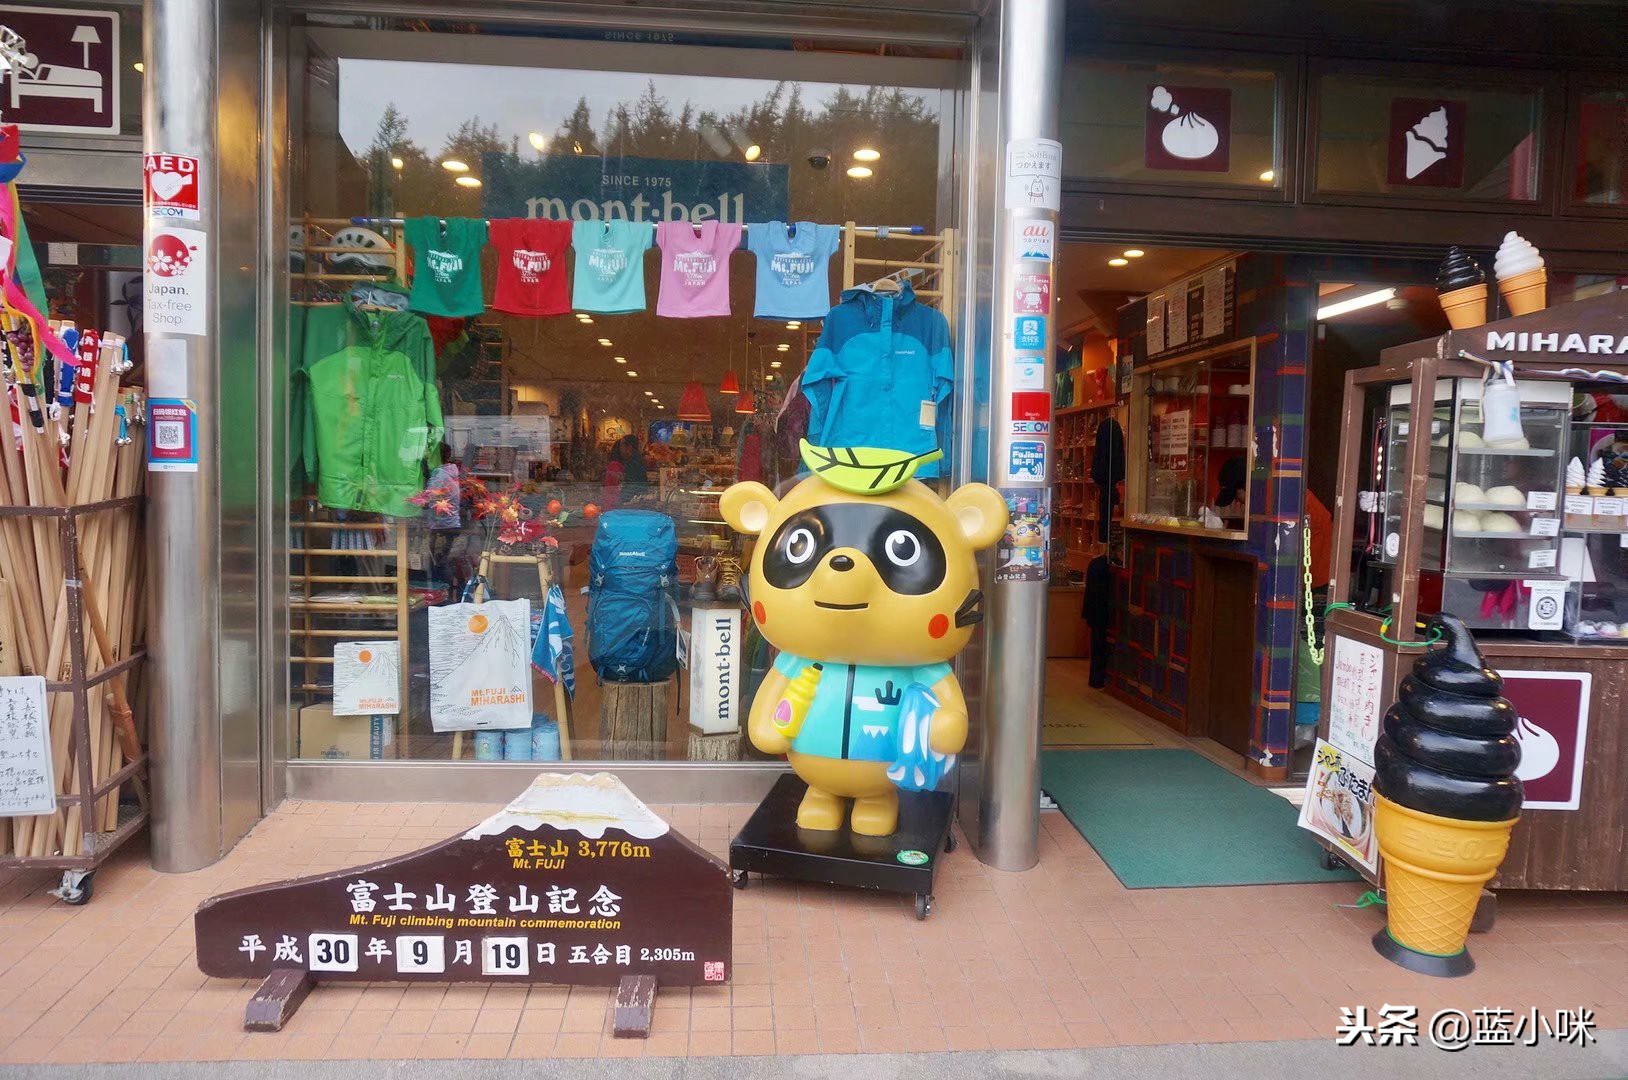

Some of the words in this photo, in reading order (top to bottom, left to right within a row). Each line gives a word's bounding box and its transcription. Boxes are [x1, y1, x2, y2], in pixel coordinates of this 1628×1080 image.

[146, 155, 195, 173] AED
[1016, 161, 1050, 170] つかえます
[602, 174, 640, 186] SINCE
[644, 176, 672, 187] 1975
[1024, 226, 1049, 237] au
[149, 284, 189, 296] Japan.
[147, 298, 192, 312] Tax-free
[153, 312, 182, 326] Shop
[1013, 422, 1049, 432] SECOM
[1012, 451, 1043, 459] Fujisan
[471, 688, 506, 697] Mt.FUJI
[471, 694, 525, 707] MIHARASHI
[505, 838, 568, 858] 富士山
[578, 841, 650, 858] 3,776m
[513, 859, 531, 869] Mt.
[535, 859, 565, 869] FUJI
[346, 880, 622, 917] 富士山登山記念
[350, 914, 368, 925] Mt.
[373, 915, 397, 926] Fuji
[400, 915, 453, 929] climbing
[457, 917, 516, 927] mountain
[520, 919, 621, 929] commemoration
[238, 934, 303, 963] 平成
[316, 939, 350, 964] 30
[365, 937, 392, 964] 年
[413, 940, 428, 965] 9
[452, 939, 473, 966] 月
[492, 944, 521, 969] 19
[536, 943, 556, 965] 日
[568, 943, 632, 966] 五合目
[640, 948, 695, 962] 2,305m
